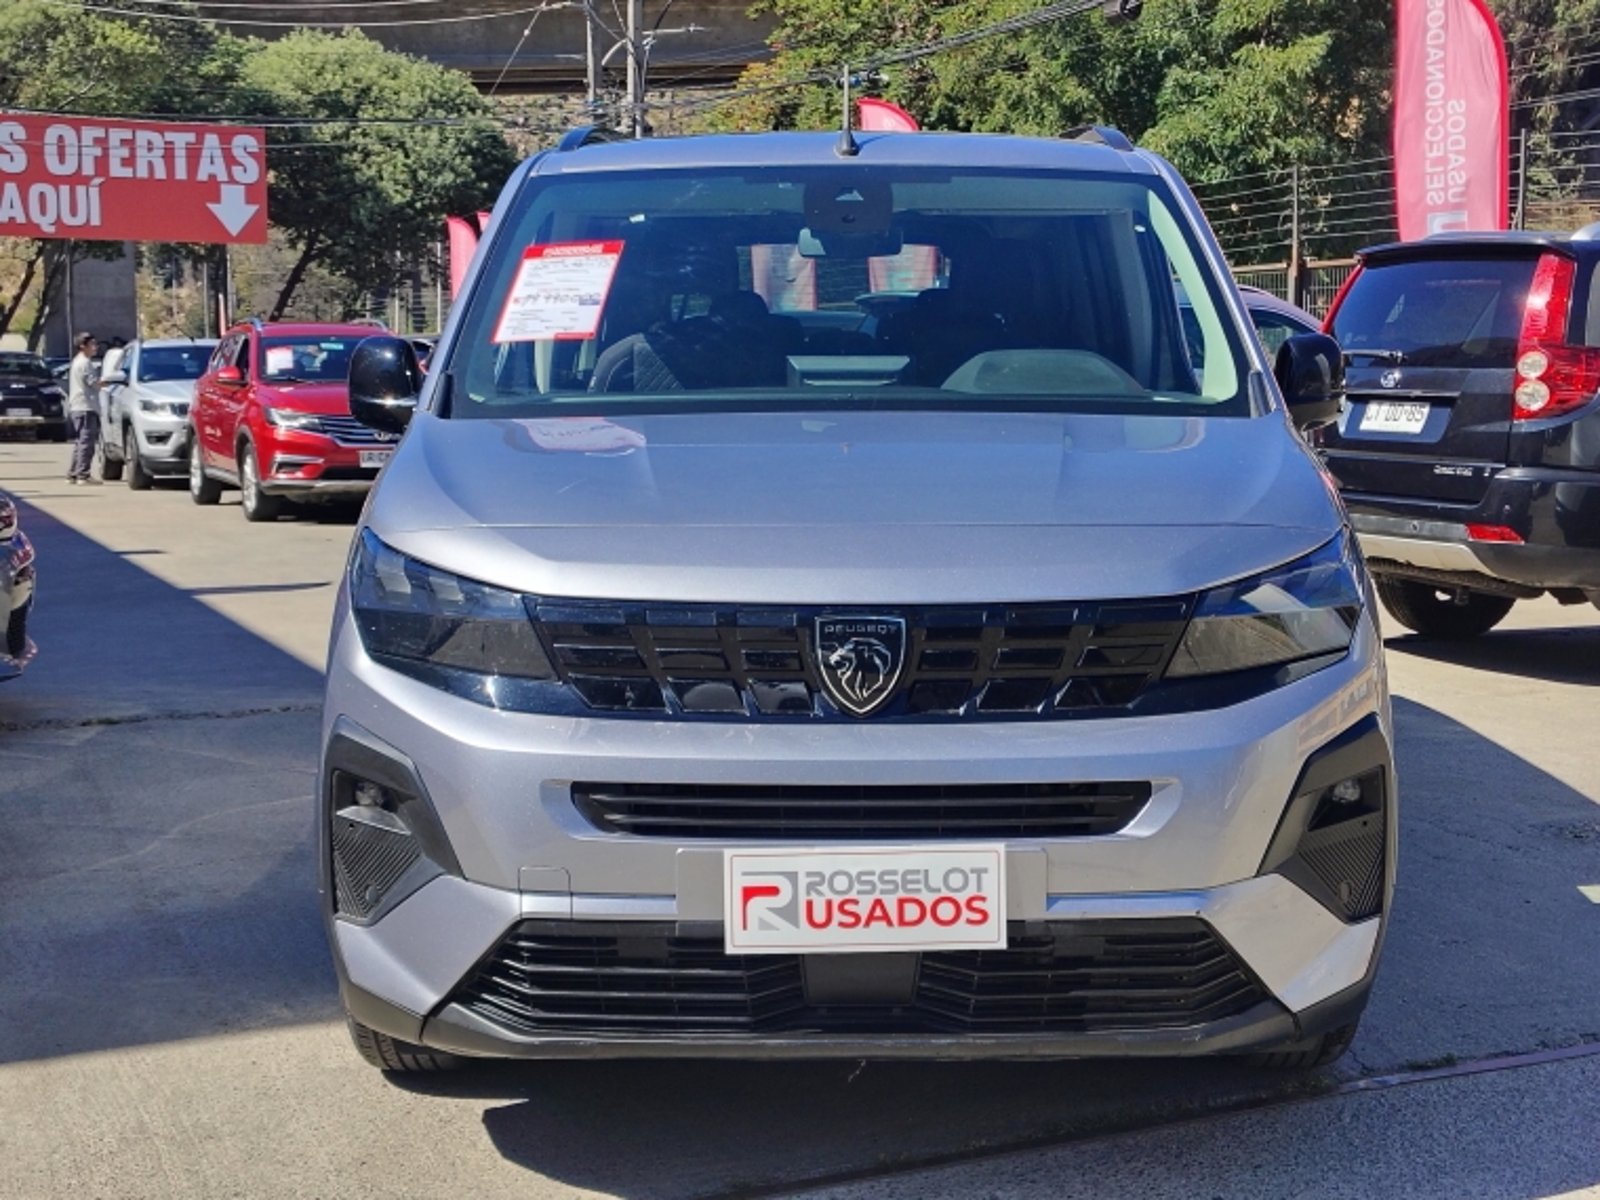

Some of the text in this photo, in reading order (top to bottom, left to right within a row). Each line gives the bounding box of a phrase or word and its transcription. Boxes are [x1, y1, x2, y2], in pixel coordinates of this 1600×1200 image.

[43, 123, 260, 184] OFERTAS
[0, 176, 105, 234] AQUÍ
[824, 624, 898, 635] PEUGEOT
[805, 867, 989, 897] ROSSELOT
[805, 895, 989, 929] USADOS
